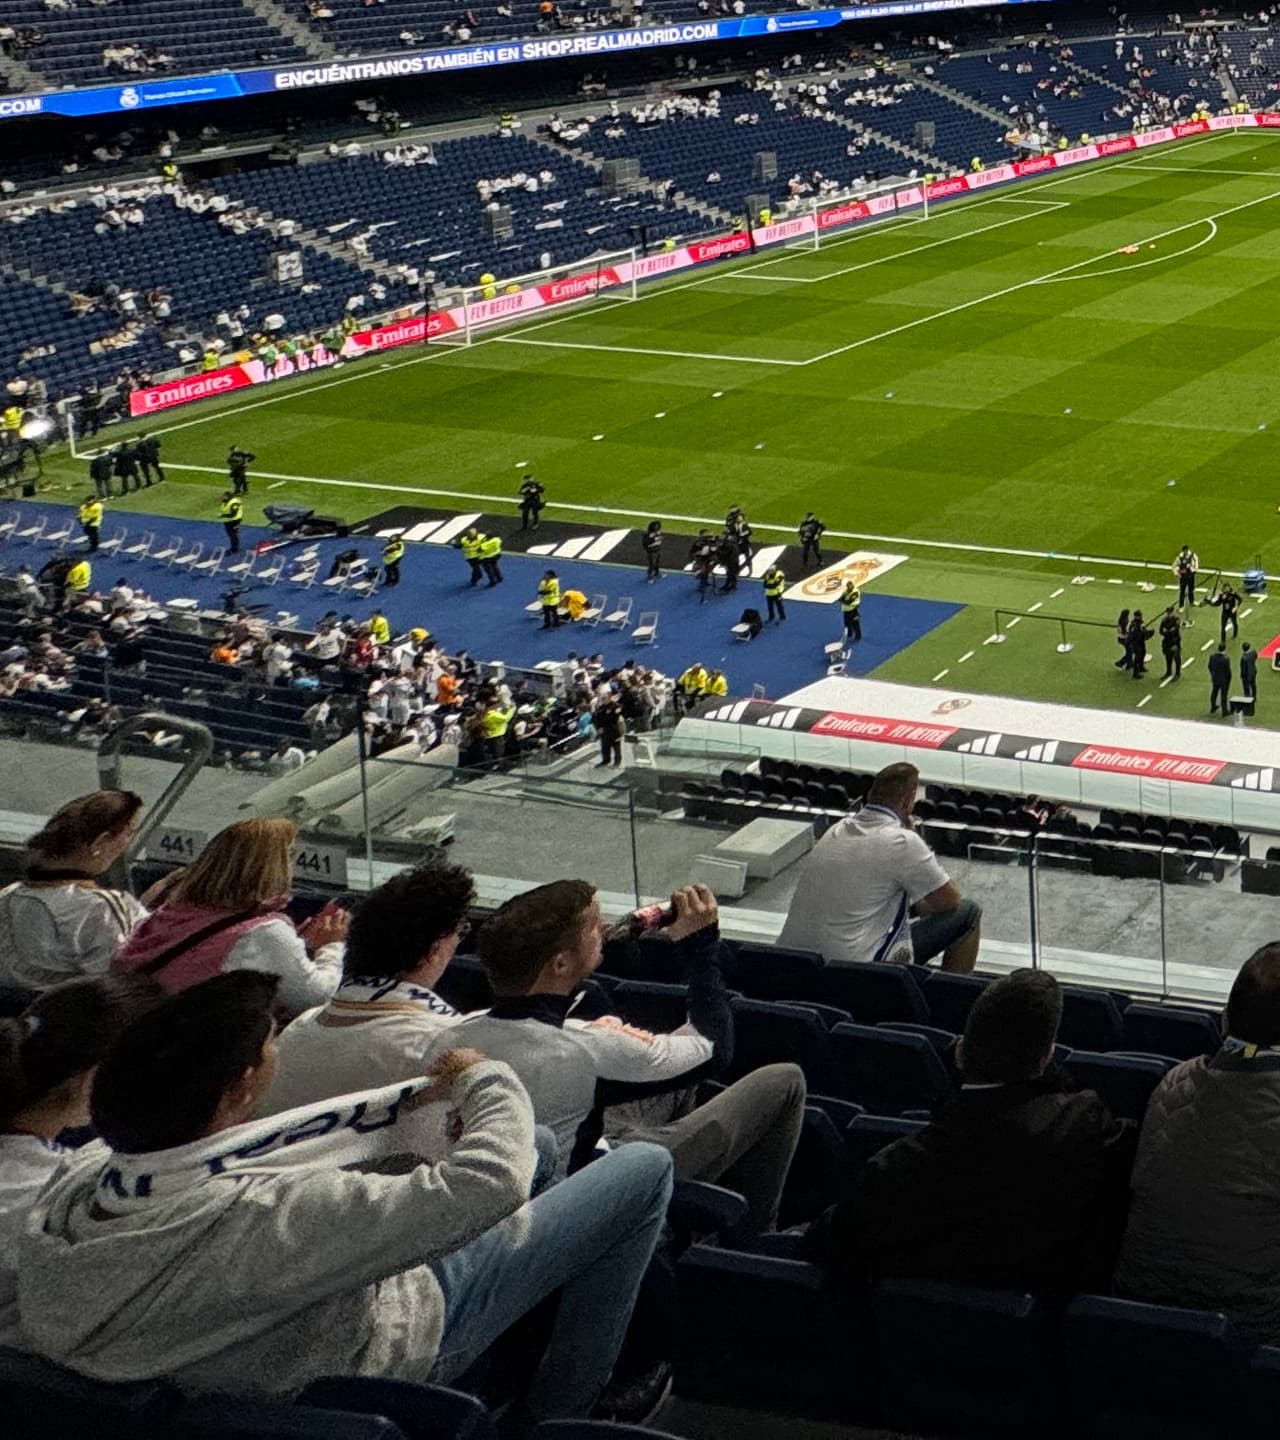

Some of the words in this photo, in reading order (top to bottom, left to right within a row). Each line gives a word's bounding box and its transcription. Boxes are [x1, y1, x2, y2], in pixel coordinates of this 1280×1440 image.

[275, 59, 423, 90] ENCUÉNTRANOS
[421, 47, 495, 71] TAMBIÉN
[496, 46, 519, 61] EN
[522, 23, 718, 60] SHOP.REALMADRID.COM
[821, 206, 863, 225] Emirates
[699, 235, 747, 260] Emirates
[646, 256, 677, 273] BETTER
[551, 273, 610, 299] Emirates
[470, 303, 486, 321] FLY
[488, 294, 523, 316] BETTER
[371, 319, 442, 347] Emirates
[144, 372, 234, 408] Emirates
[818, 714, 888, 736] Emirates
[1079, 748, 1153, 769] Emirates
[1174, 760, 1217, 777] BETTER
[161, 835, 193, 857] 441
[295, 850, 331, 874] 441
